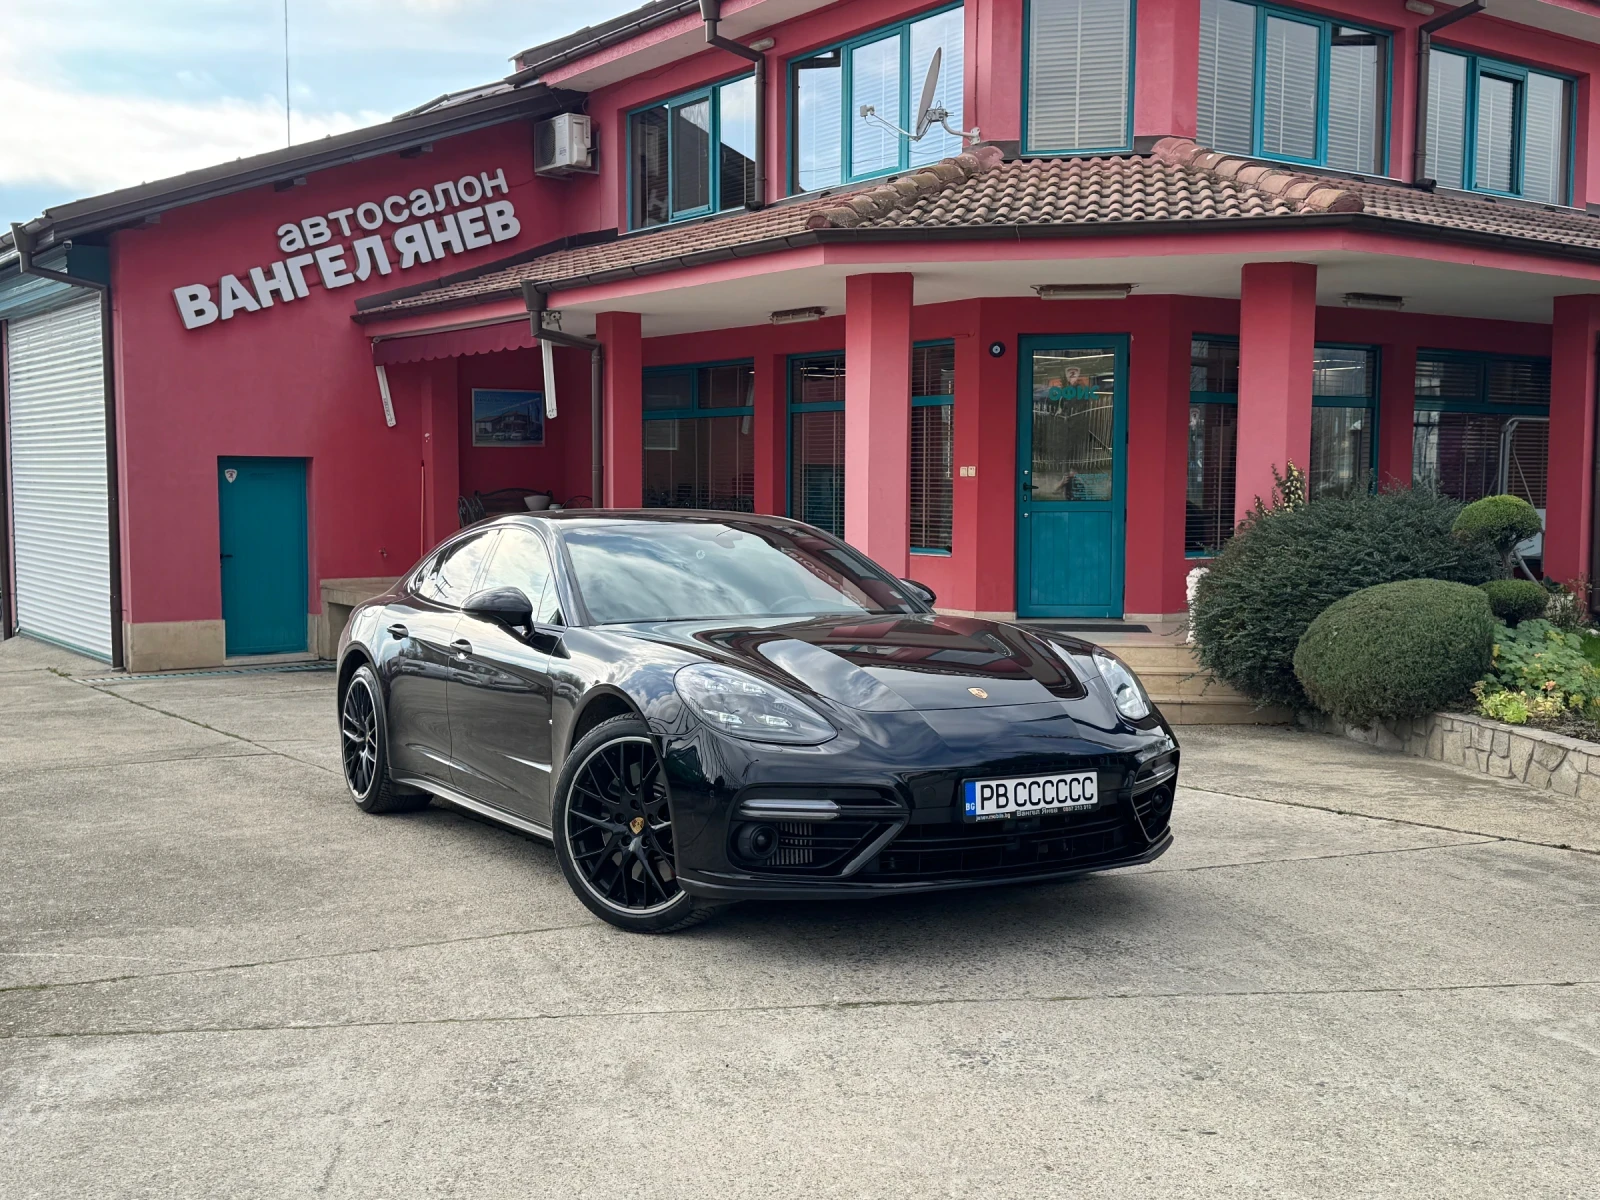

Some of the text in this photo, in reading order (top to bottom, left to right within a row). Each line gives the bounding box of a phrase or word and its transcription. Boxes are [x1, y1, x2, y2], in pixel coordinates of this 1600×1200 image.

[173, 200, 521, 330] ВАНГЕЛ ЯНЕВ
[965, 776, 1094, 811] BG PB CCCCCC
